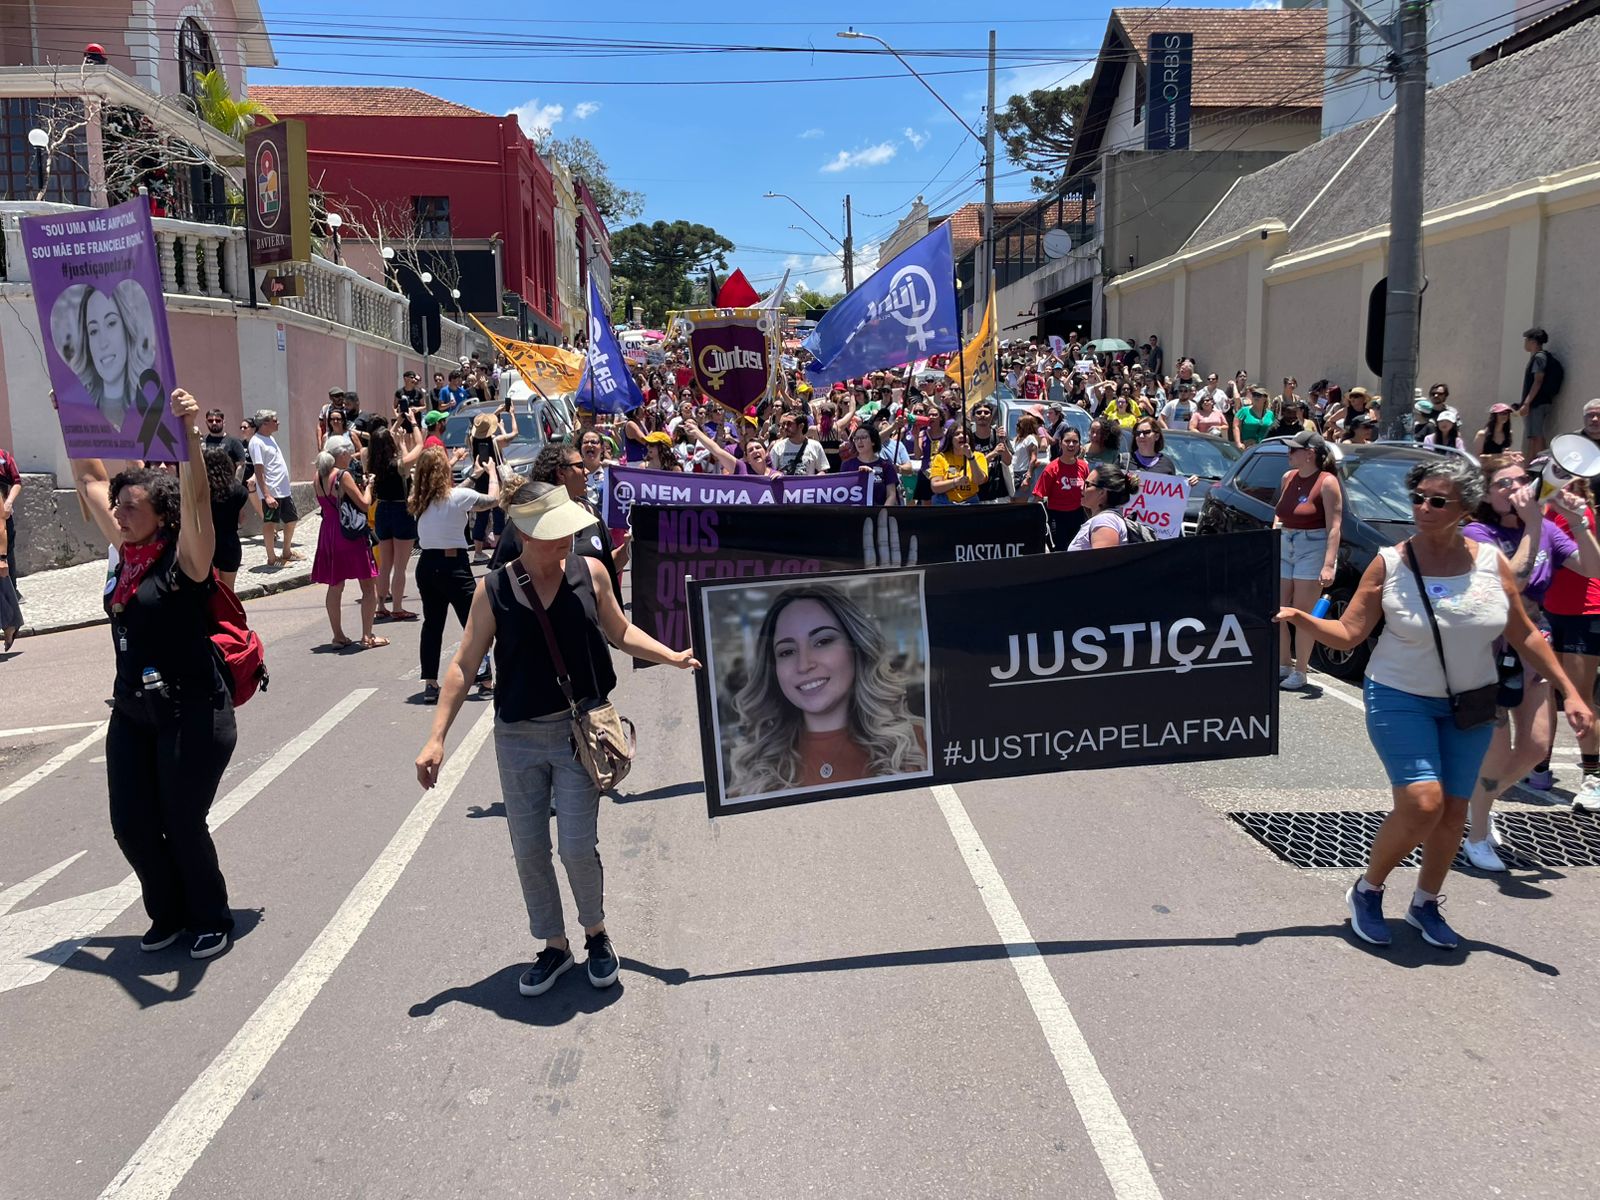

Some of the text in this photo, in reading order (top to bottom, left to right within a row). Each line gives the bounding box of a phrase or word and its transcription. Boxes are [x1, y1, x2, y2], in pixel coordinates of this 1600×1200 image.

[1163, 35, 1180, 101] ORBIS
[66, 222, 87, 235] UMA
[89, 217, 107, 233] MÃE
[32, 245, 51, 259] SOU
[53, 242, 73, 257] MÃE
[75, 243, 86, 255] DE
[256, 234, 285, 250] BAVIERA
[641, 483, 863, 505] NEM UMA A MENOS
[1131, 494, 1145, 508] A
[1123, 508, 1170, 527] ENOS
[658, 510, 719, 554] NOS
[990, 614, 1252, 680] JUSTIÇA
[944, 714, 1270, 767] #JUSTIÇAPELAFRAN
